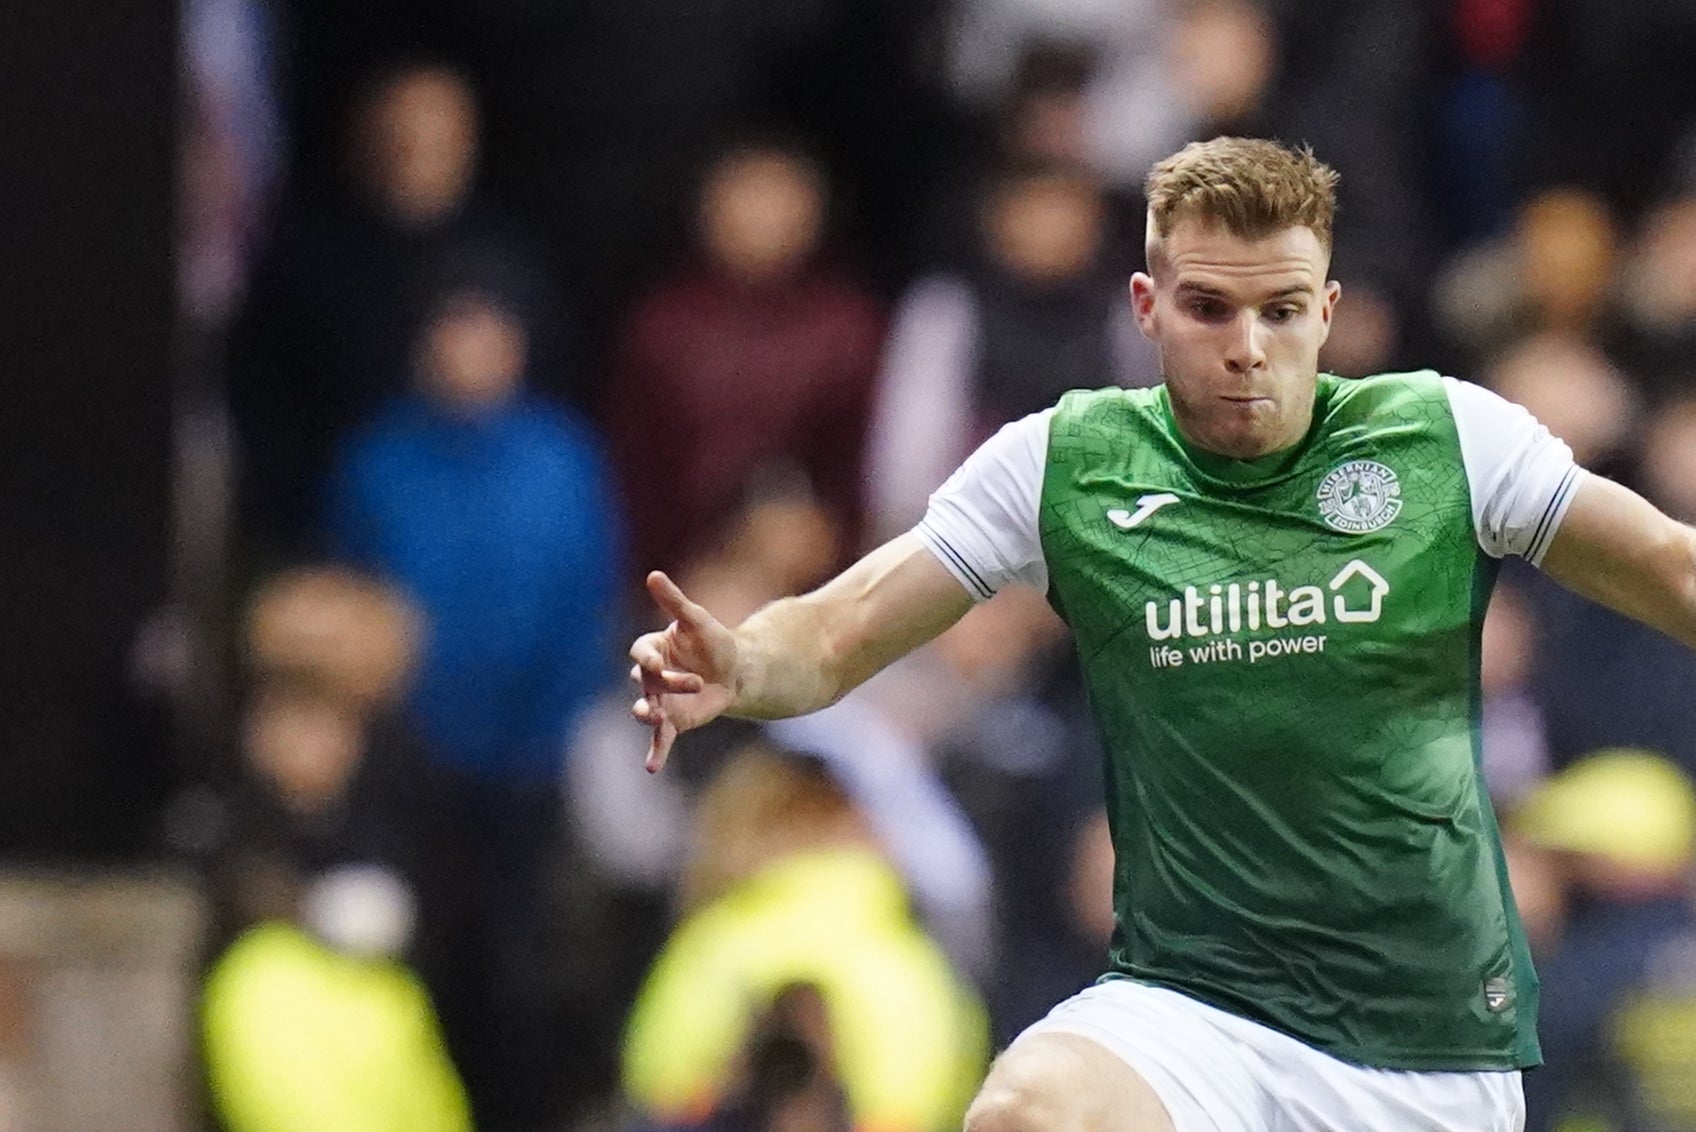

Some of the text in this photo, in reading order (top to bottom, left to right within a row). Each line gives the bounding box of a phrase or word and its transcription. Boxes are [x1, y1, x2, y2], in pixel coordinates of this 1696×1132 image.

[1145, 579, 1327, 641] utilita
[1150, 635, 1327, 668] life with power
